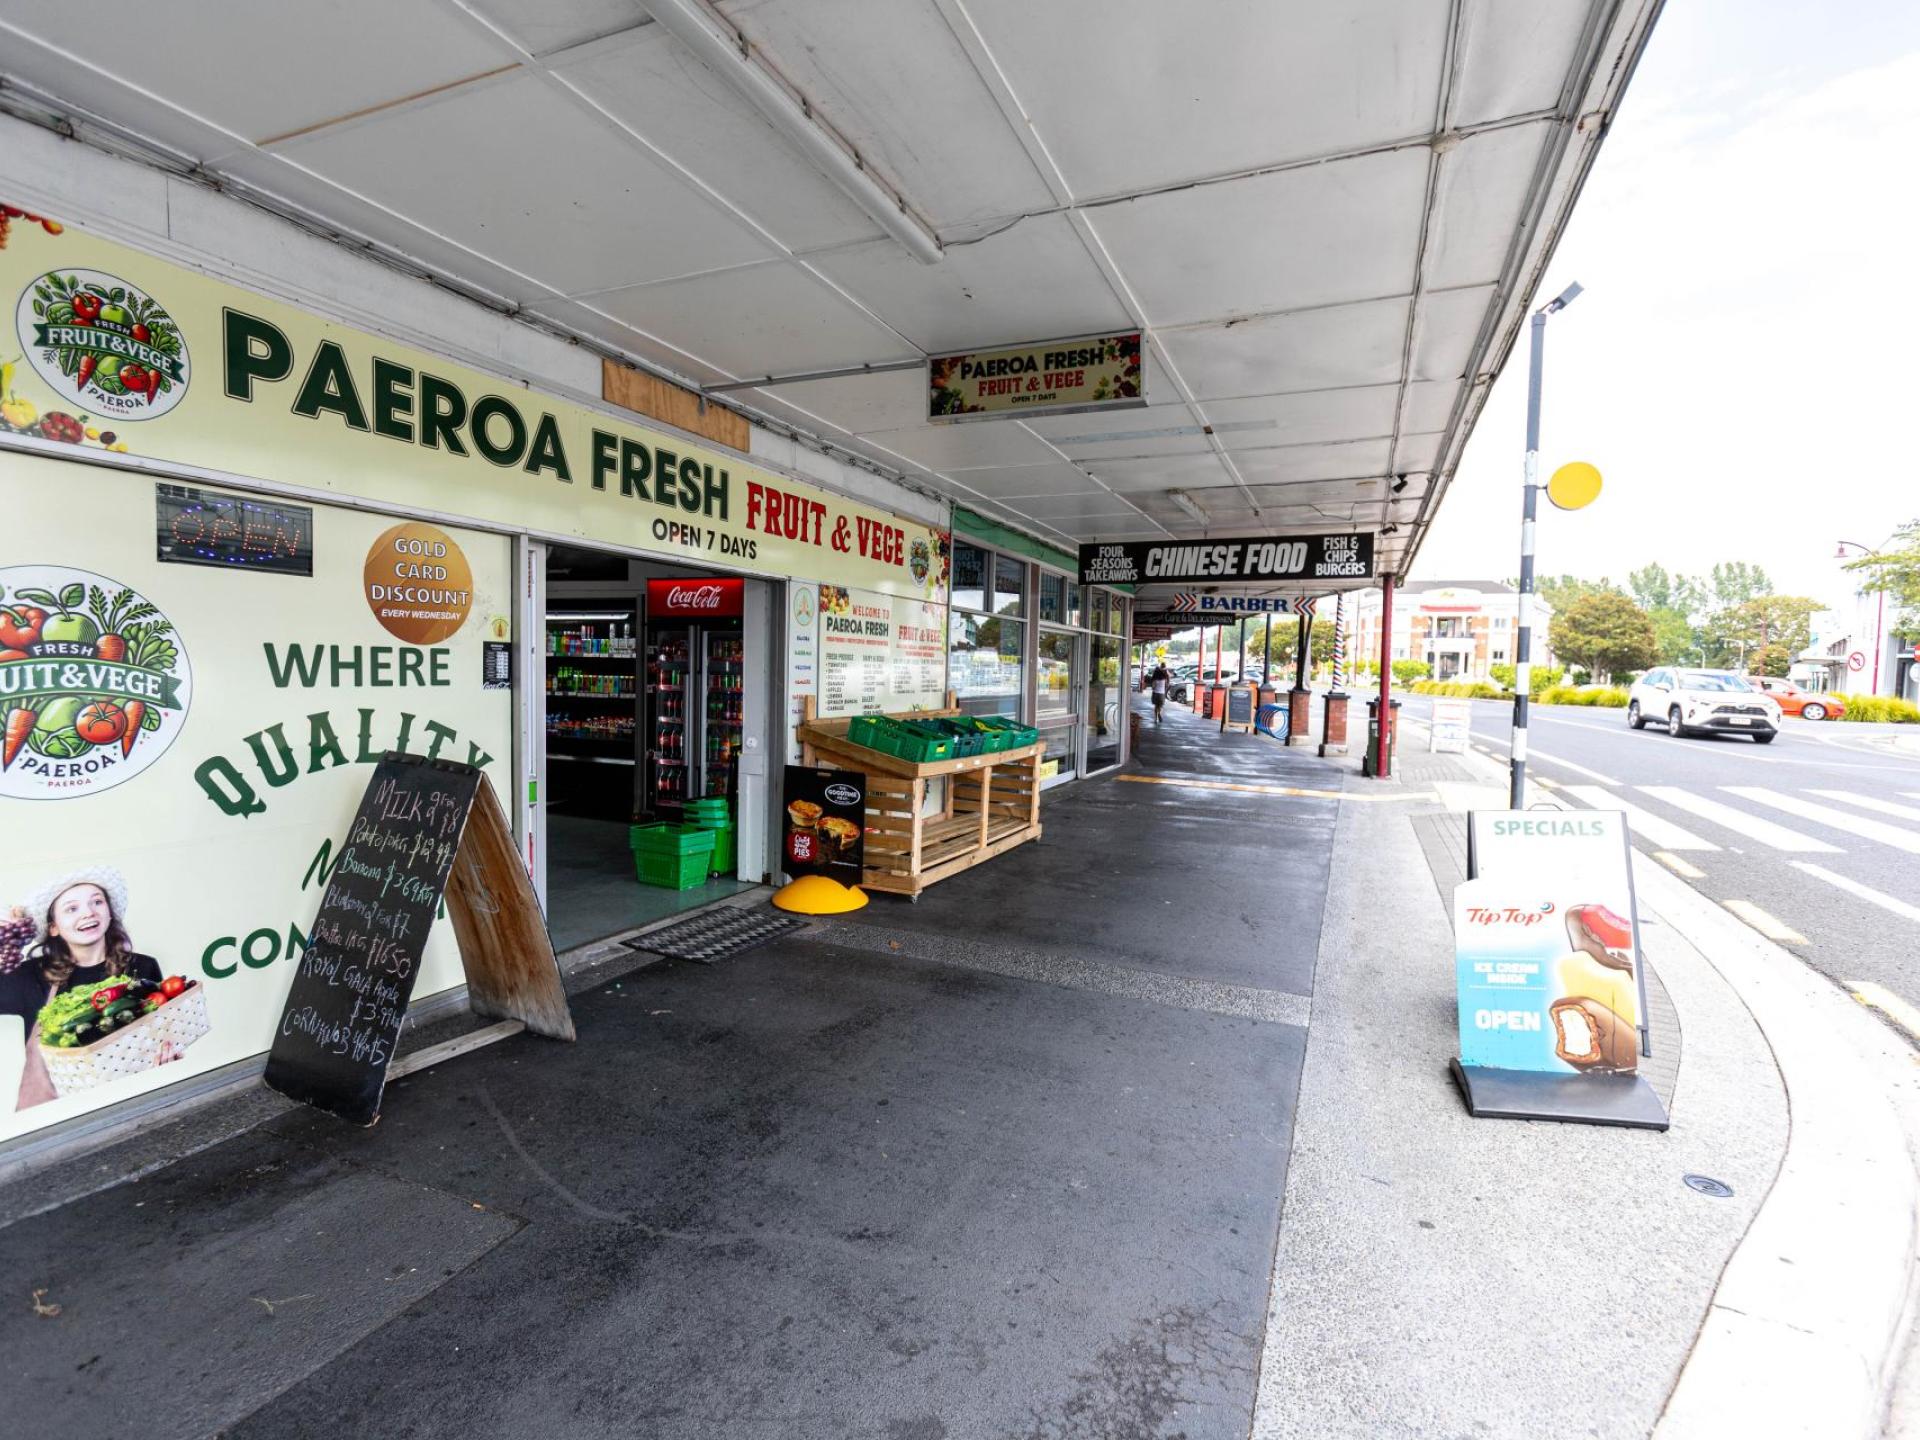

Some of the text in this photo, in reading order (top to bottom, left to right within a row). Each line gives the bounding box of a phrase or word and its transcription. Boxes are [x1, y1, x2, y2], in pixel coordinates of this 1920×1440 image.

[94, 319, 131, 335] FRESH
[47, 326, 173, 373] FRUIT&VEGE
[960, 346, 1105, 380] PAEROA FRESH
[978, 369, 1085, 397] FRUIT & VEGE
[87, 387, 145, 409] PAEROA
[1011, 392, 1057, 404] OPEN 7 DAYS
[222, 305, 729, 522] PAEROA FRESH
[746, 480, 827, 546] FRUIT
[831, 514, 851, 553] &
[855, 515, 905, 567] VEGE
[171, 514, 301, 557] OPEN
[652, 518, 757, 560] OPEN 7 DAYS
[1323, 536, 1359, 550] FISH &
[394, 538, 448, 558] GOLD
[1099, 545, 1125, 559] FOUR
[1324, 549, 1357, 563] CHIPS
[1090, 556, 1133, 571] SEASONS
[1145, 542, 1308, 577] CHINESE FOOD
[1315, 561, 1366, 577] BURGERS
[395, 562, 448, 581] CARD
[1084, 568, 1138, 583] TAKEAWAYS
[370, 583, 469, 606] DISCOUNT
[667, 585, 724, 609] Coca-Cola
[1200, 596, 1289, 612] BARBER
[381, 608, 462, 621] EVERY WEDNESDAY
[852, 604, 890, 620] WELCOME TO
[826, 616, 889, 637] PAEROA FRESH
[898, 625, 919, 641] FRUIT
[33, 643, 94, 657] FRESH
[263, 643, 451, 688] WHERE
[0, 663, 162, 700] UIT&VEGE
[20, 754, 117, 778] PAEROA
[195, 708, 494, 819] QUALITY
[48, 778, 92, 788] PAEROA
[375, 778, 422, 821] MILK
[1493, 820, 1604, 836] SPECIALS
[1466, 908, 1542, 926] Tip Top
[1475, 1009, 1541, 1031] OPEN
